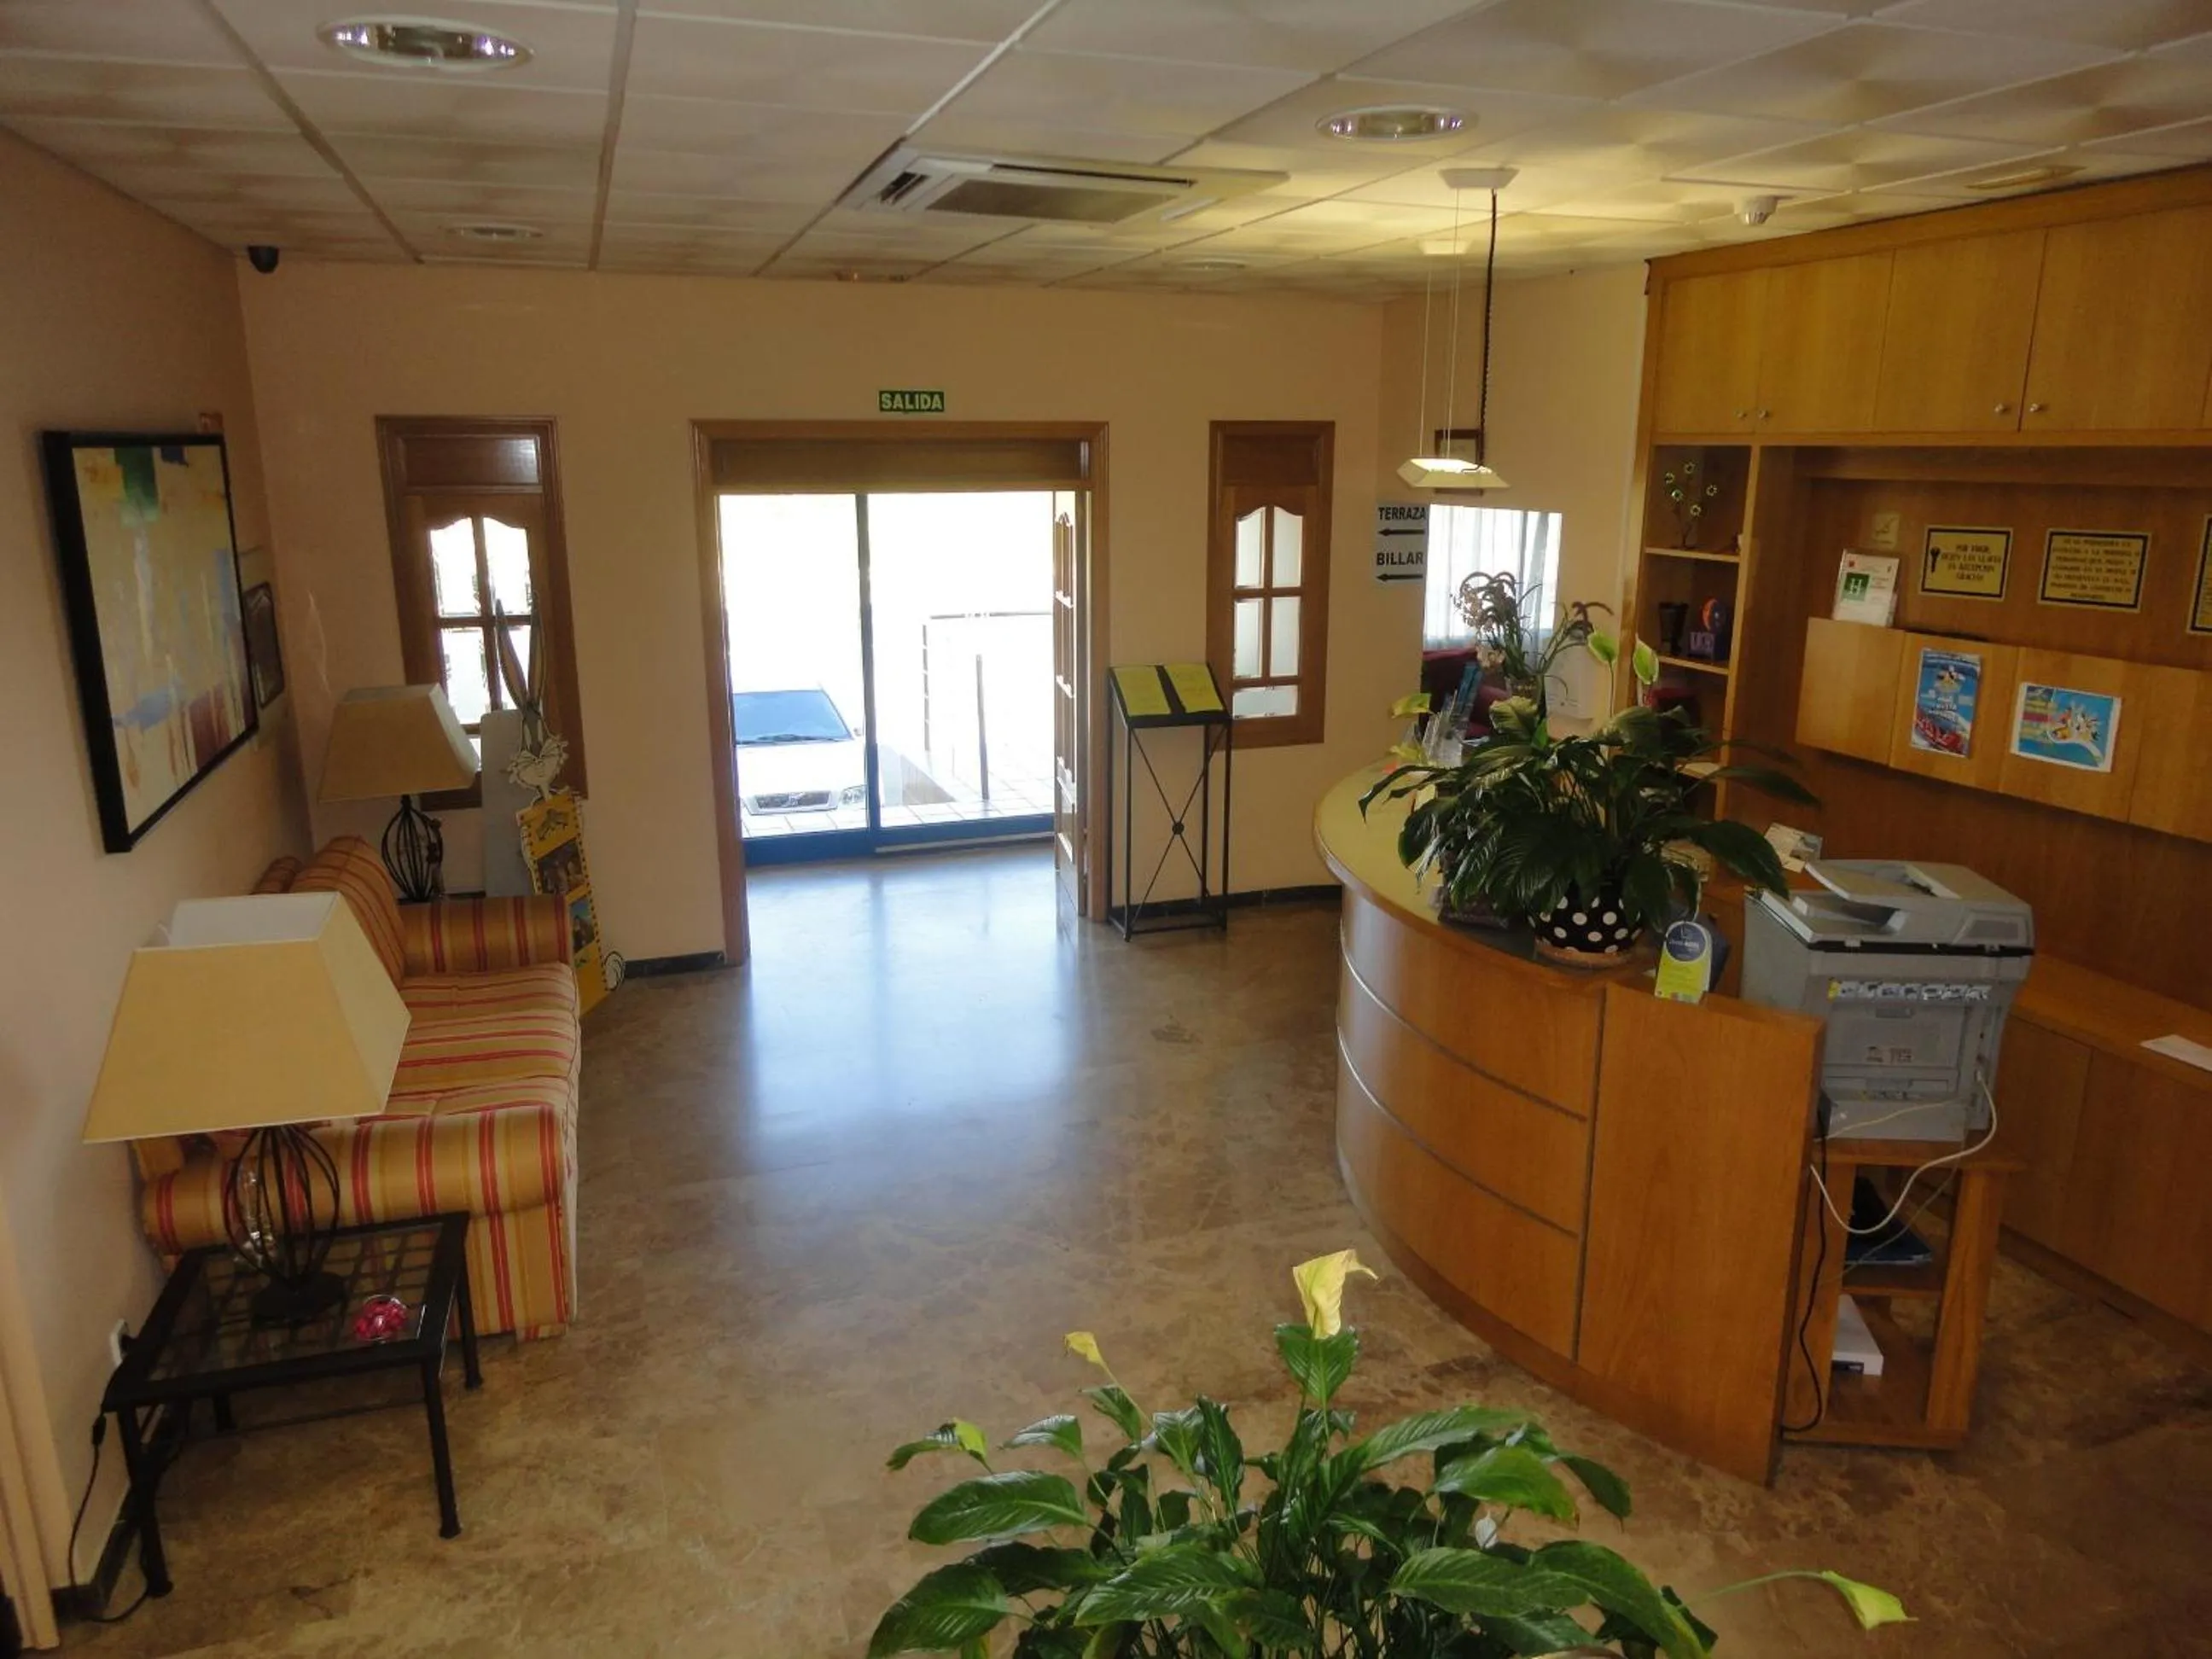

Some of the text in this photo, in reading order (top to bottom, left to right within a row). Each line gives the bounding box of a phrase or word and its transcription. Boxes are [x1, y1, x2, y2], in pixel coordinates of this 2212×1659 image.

[882, 393, 943, 410] SALIDA
[1378, 506, 1426, 521] TERRAZA
[1377, 551, 1423, 566] BILLAR
